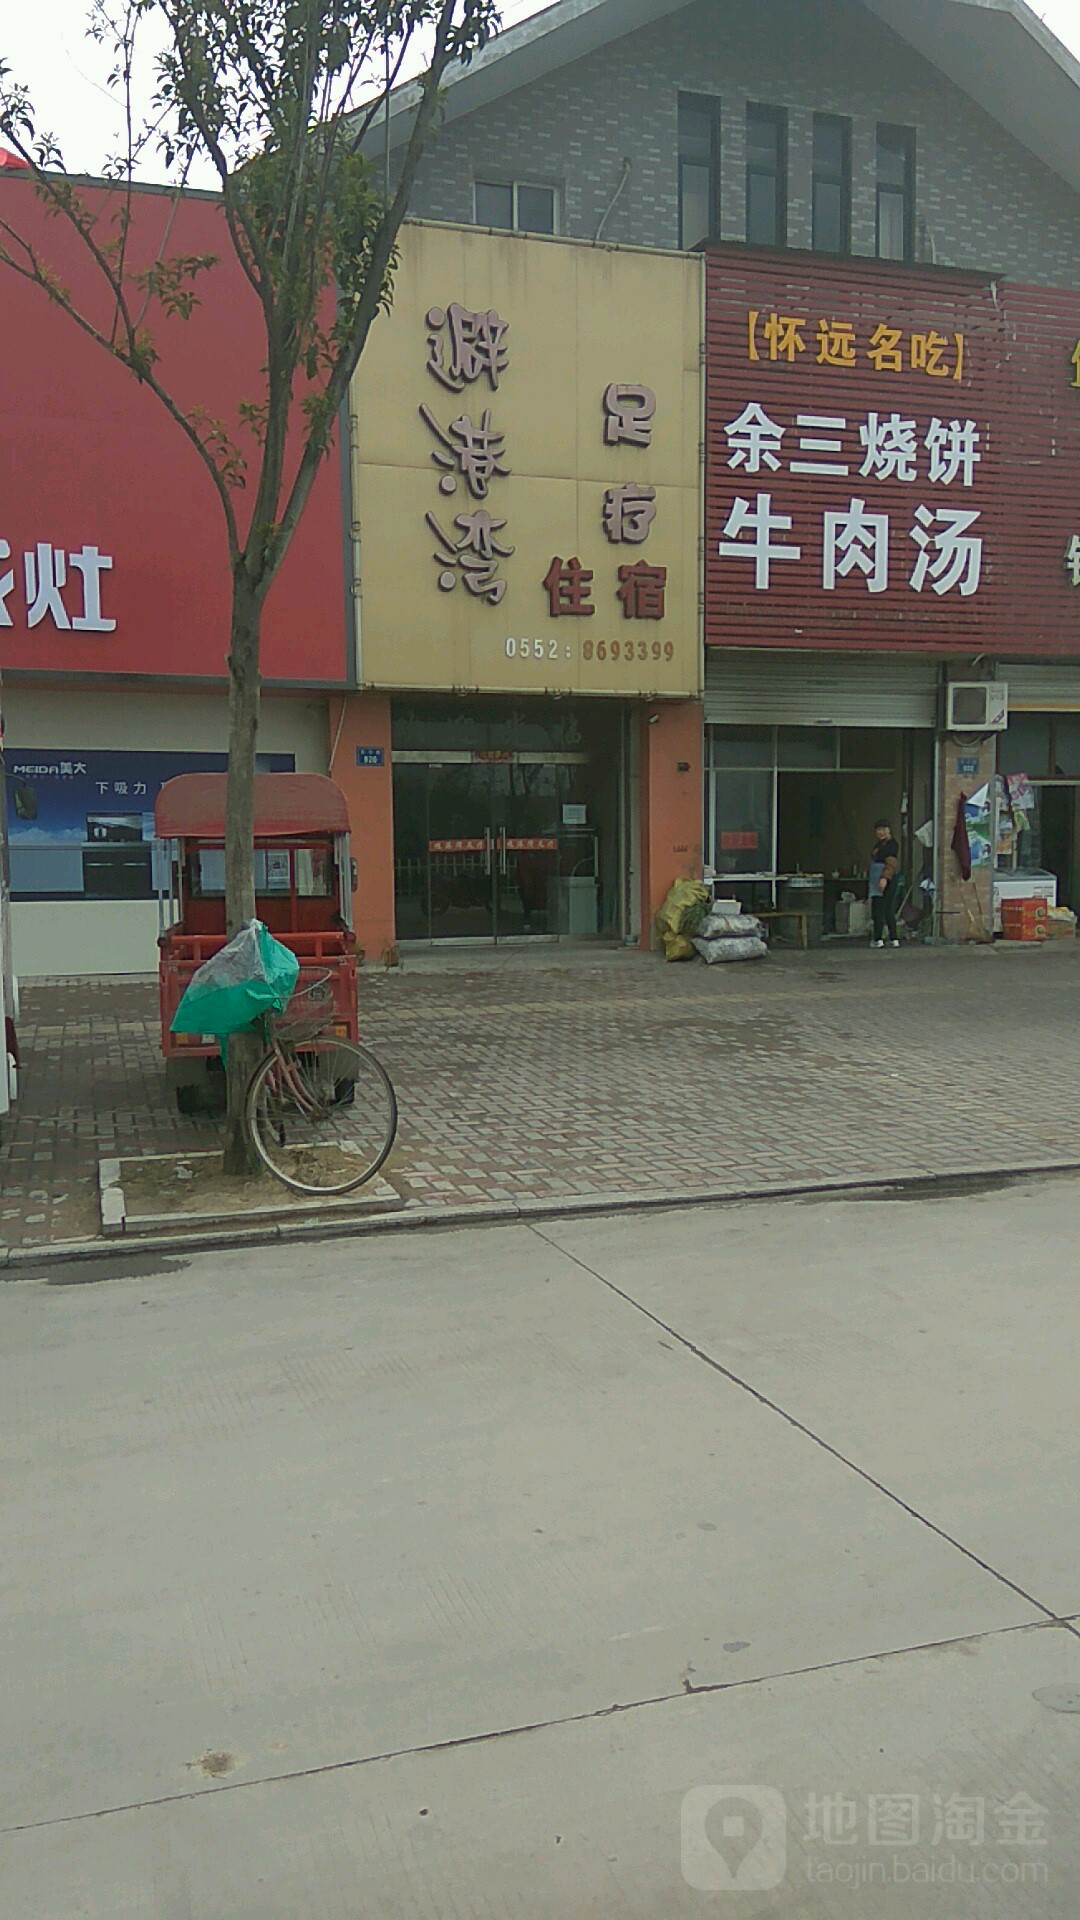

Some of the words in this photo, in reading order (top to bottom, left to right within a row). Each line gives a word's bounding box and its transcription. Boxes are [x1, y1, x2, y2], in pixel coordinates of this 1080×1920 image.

[603, 382, 657, 545] 足疗
[723, 402, 981, 487] 余三烧饼
[718, 493, 983, 596] 牛肉汤
[543, 556, 667, 620] 住宿
[95, 781, 147, 795] 下吸力
